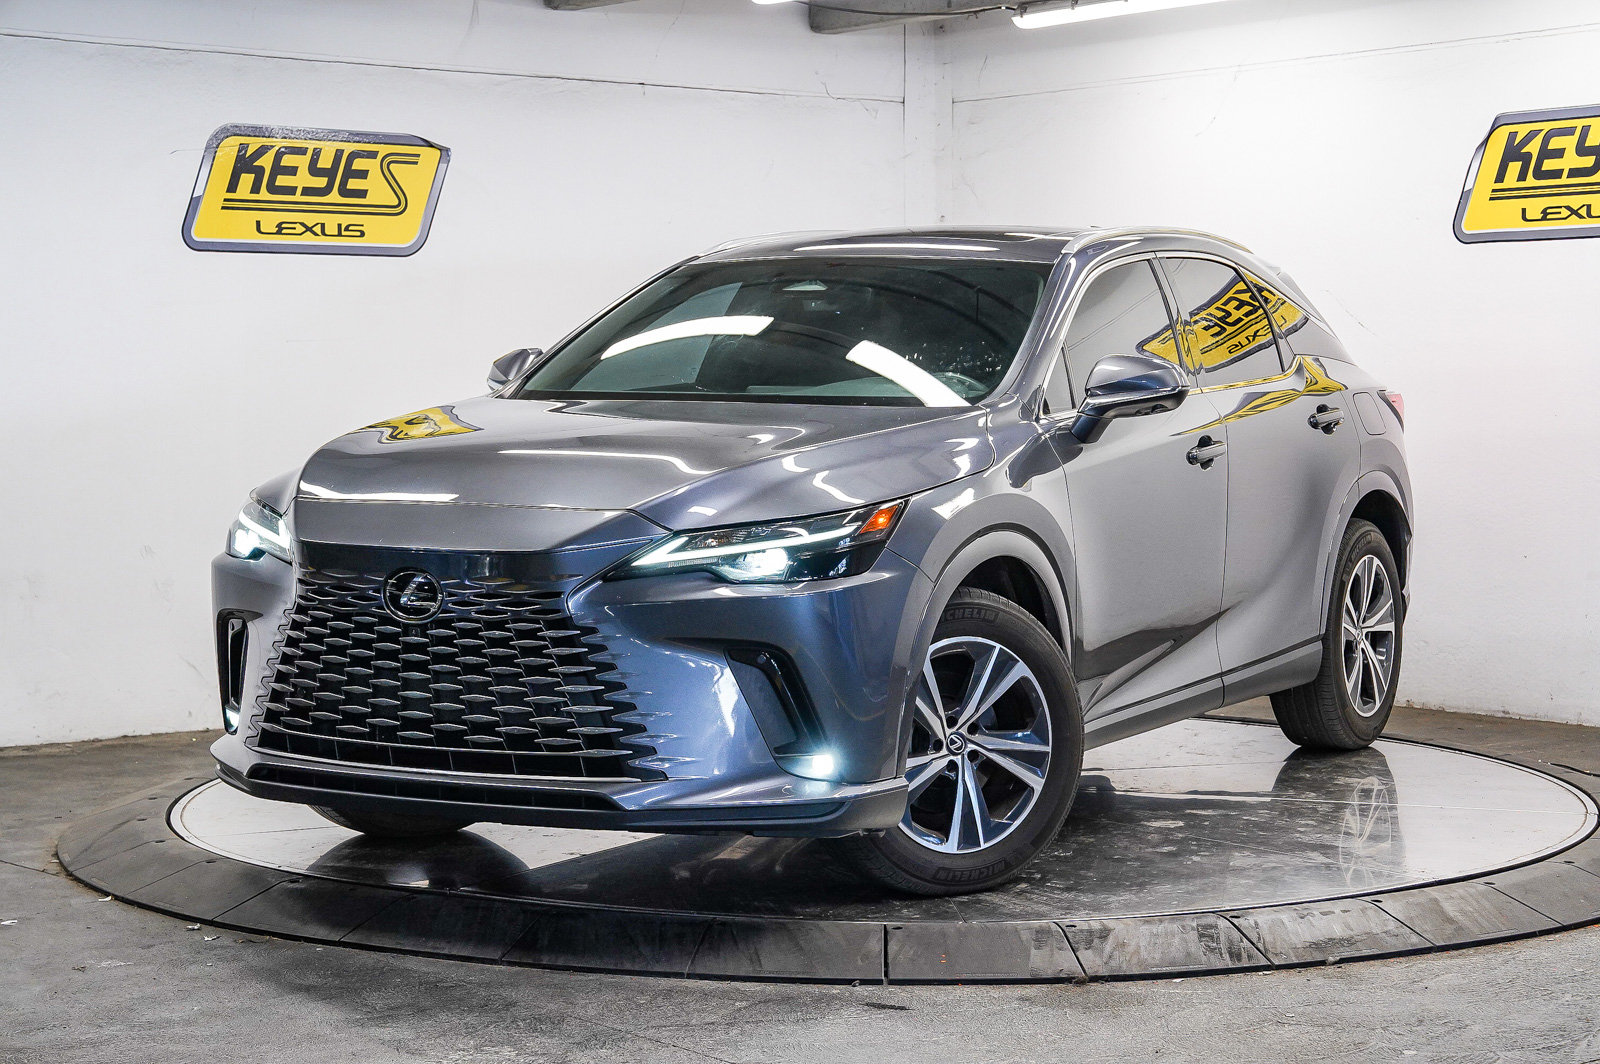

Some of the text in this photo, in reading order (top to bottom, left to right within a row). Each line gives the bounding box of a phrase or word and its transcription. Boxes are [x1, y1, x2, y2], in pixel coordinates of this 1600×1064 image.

[222, 143, 421, 216] KEYES
[255, 220, 366, 238] LEXUS
[940, 608, 995, 622] ICHELIN
